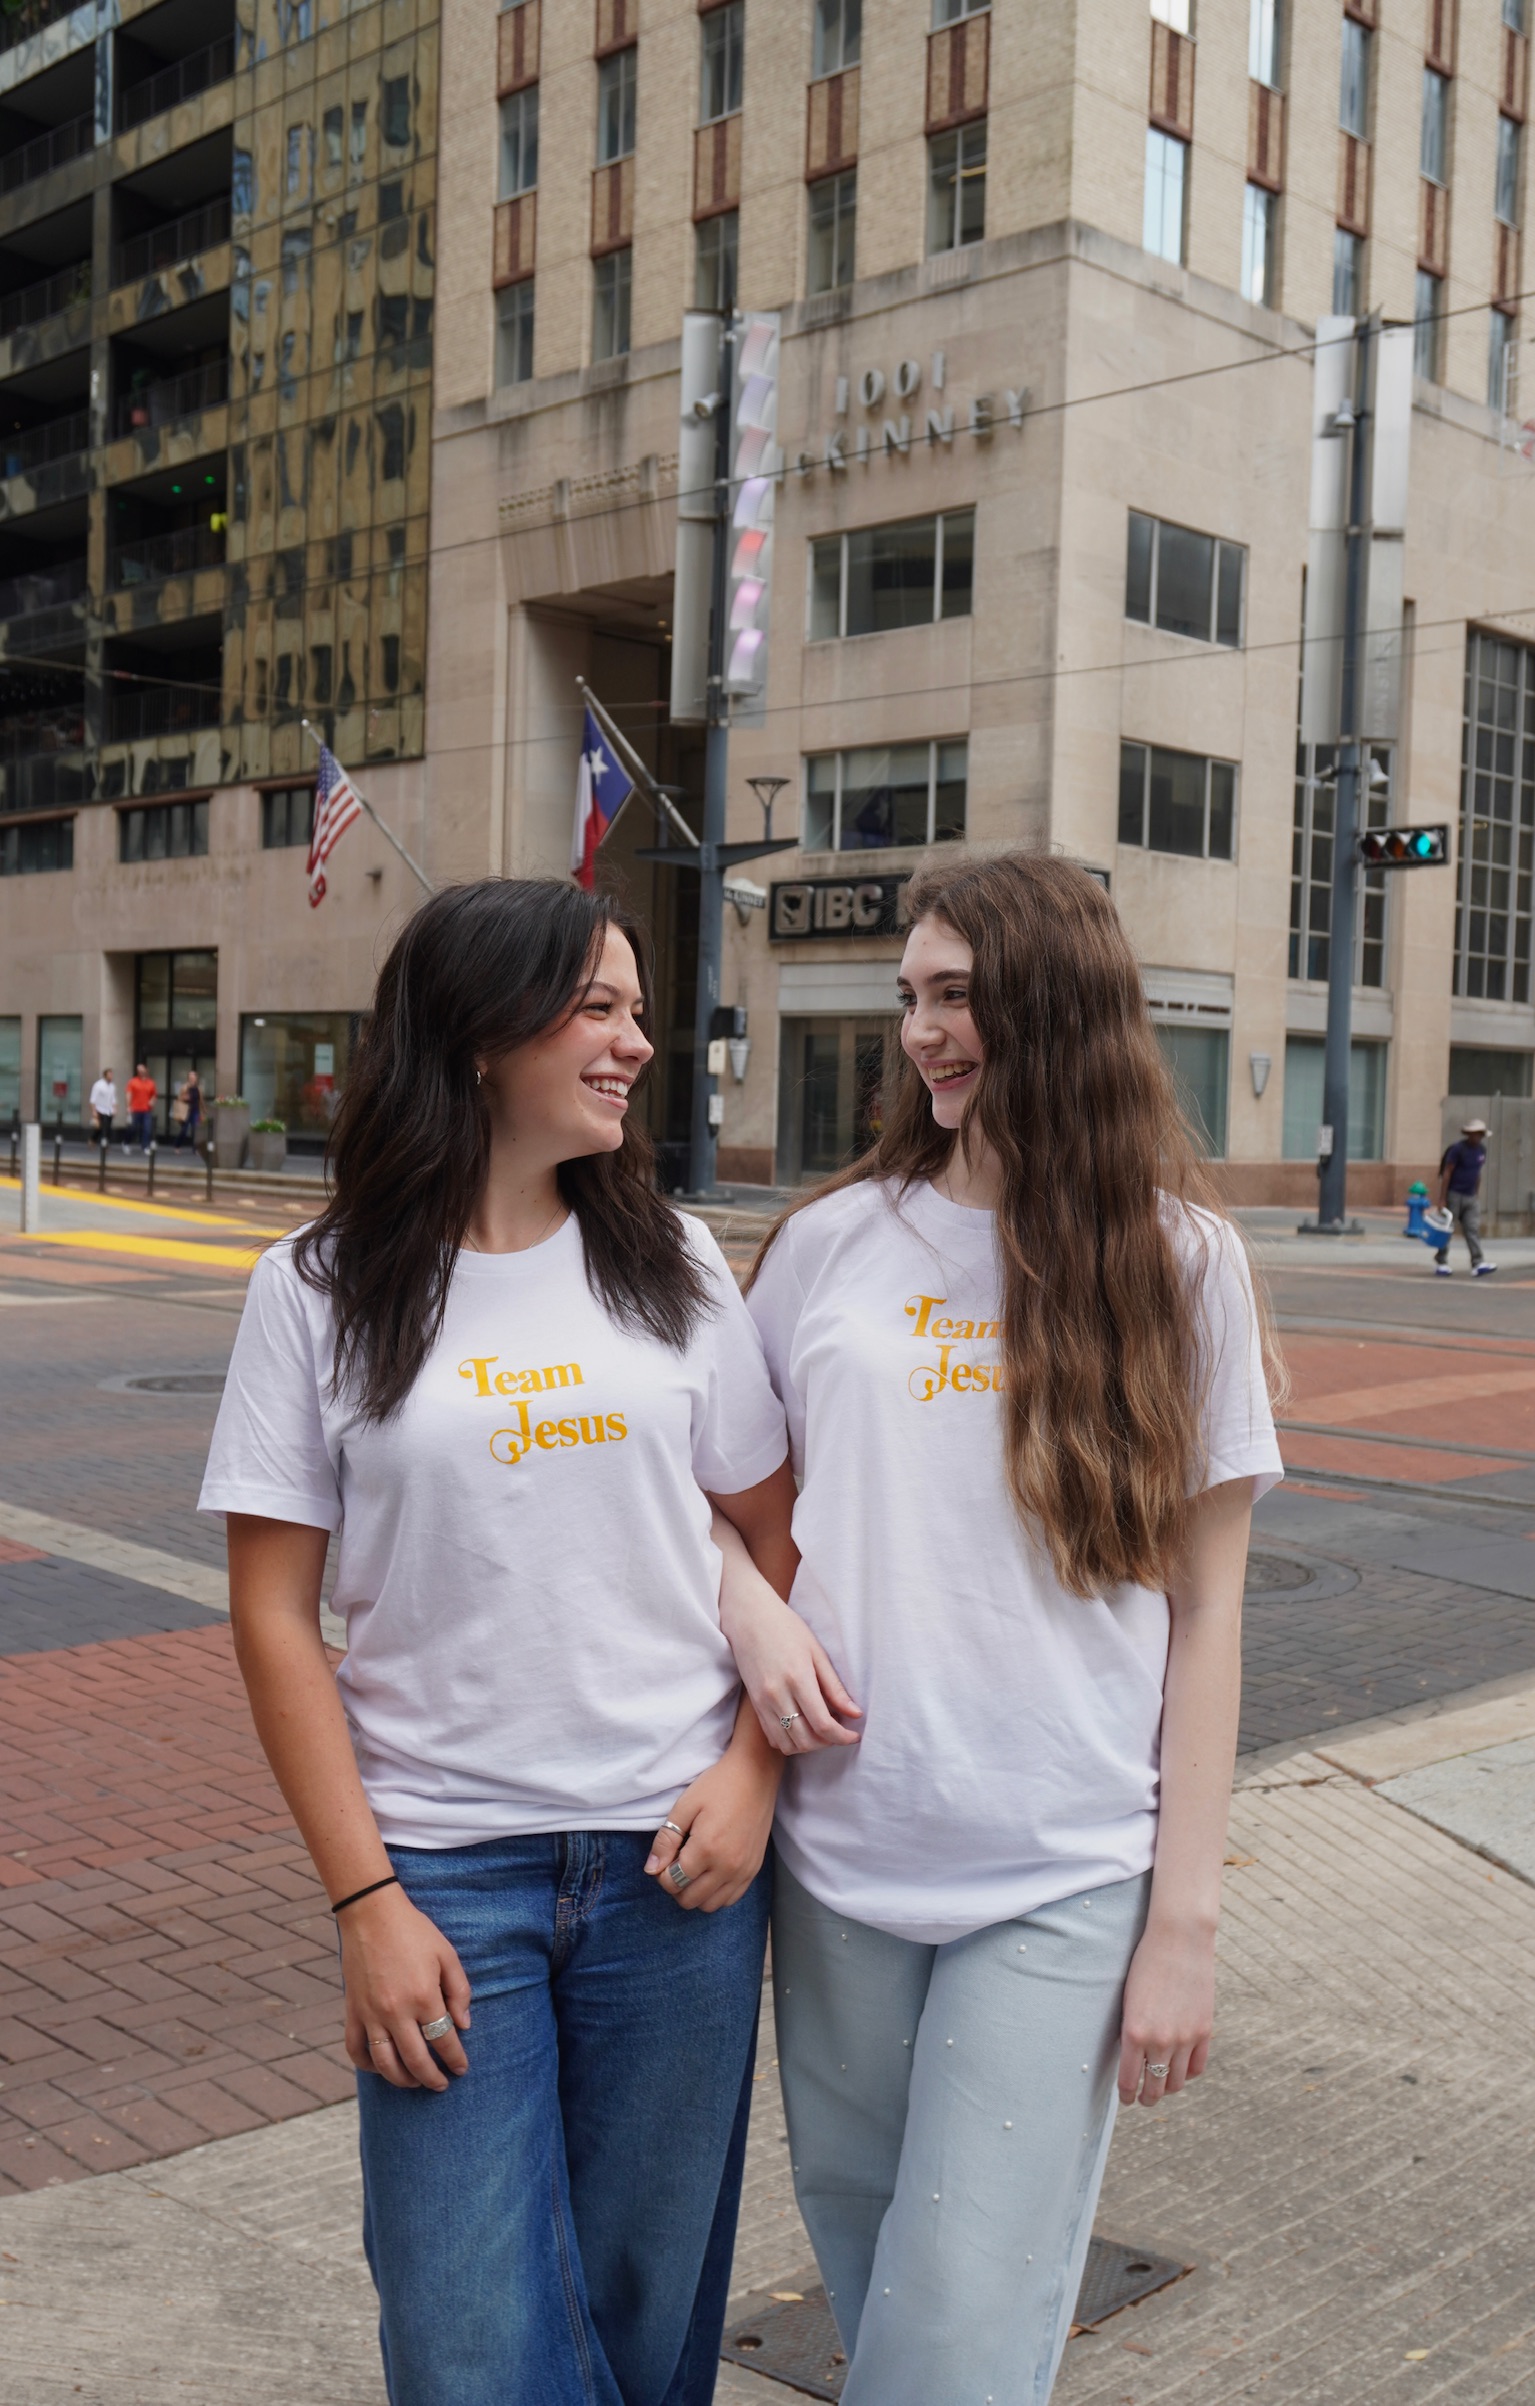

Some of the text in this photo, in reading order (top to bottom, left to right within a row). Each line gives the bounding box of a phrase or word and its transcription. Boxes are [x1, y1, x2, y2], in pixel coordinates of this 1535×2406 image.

[835, 350, 945, 415] 1001
[814, 885, 882, 928] IBC
[904, 1295, 1007, 1339] Team
[457, 1356, 585, 1397] Team
[908, 1344, 1006, 1402] Jesu
[489, 1399, 628, 1465] Jesus
